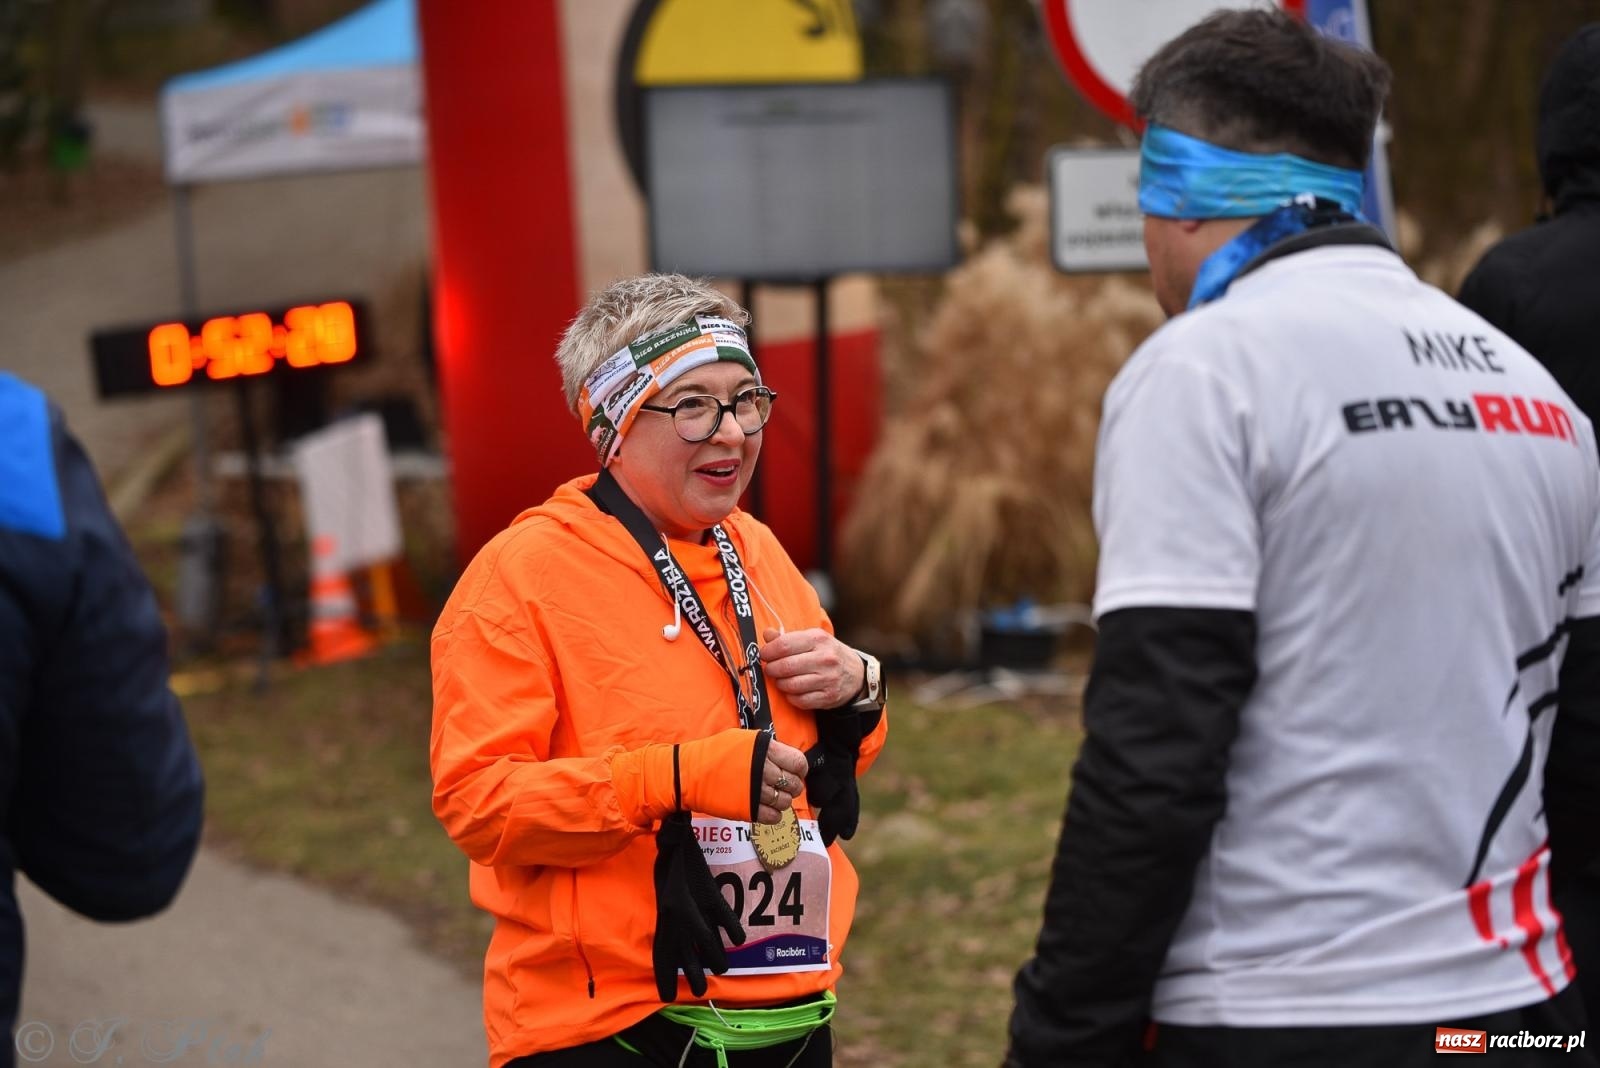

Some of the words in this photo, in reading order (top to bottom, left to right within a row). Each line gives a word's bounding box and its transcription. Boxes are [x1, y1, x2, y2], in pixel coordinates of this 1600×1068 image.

[1402, 328, 1506, 374] MIKE
[701, 847, 715, 856] uty
[715, 846, 732, 854] 2025
[776, 946, 807, 958] Racibórz
